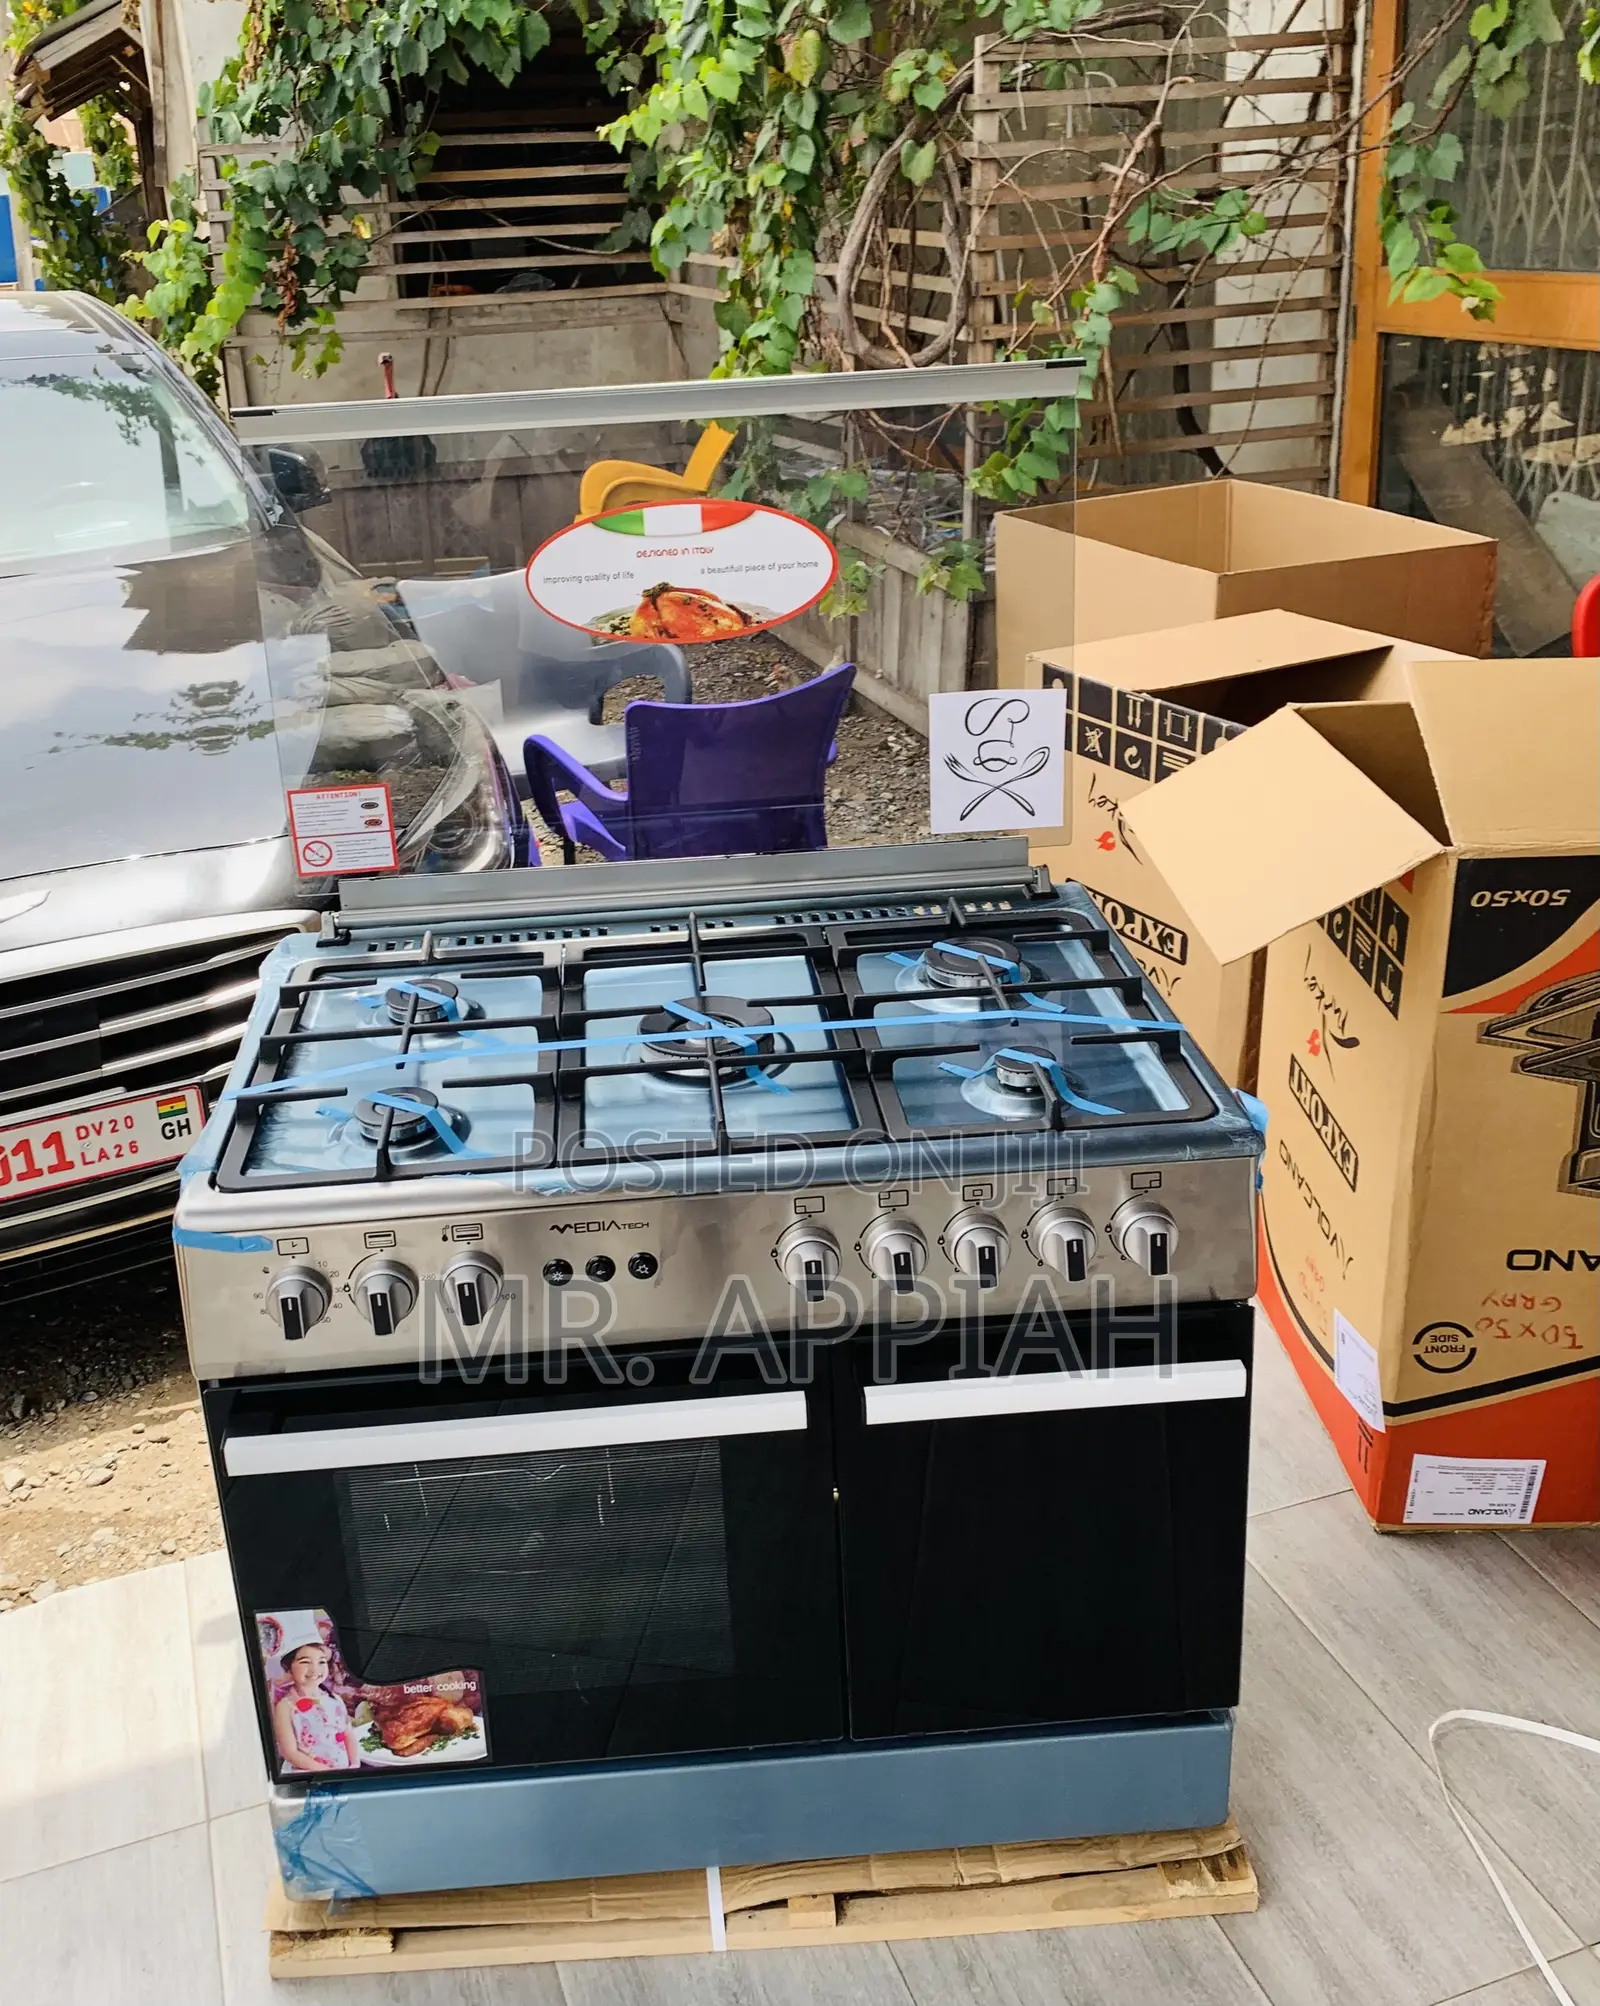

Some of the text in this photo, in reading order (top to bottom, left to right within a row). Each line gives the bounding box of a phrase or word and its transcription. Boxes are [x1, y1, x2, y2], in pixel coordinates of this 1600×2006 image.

[636, 549, 678, 559] DESIGNED
[745, 565, 766, 573] piece
[777, 563, 795, 572] your
[584, 573, 611, 582] quality
[612, 572, 620, 580] of
[622, 571, 634, 579] life
[1470, 889, 1571, 907] 50x50
[1290, 1056, 1356, 1185] EXPORT
[161, 1118, 192, 1141] GH
[1279, 1139, 1342, 1262] VOLCANO
[1429, 1334, 1459, 1343] SIDE
[1423, 1344, 1465, 1354] FRONT
[403, 1680, 476, 1694] better cooking
